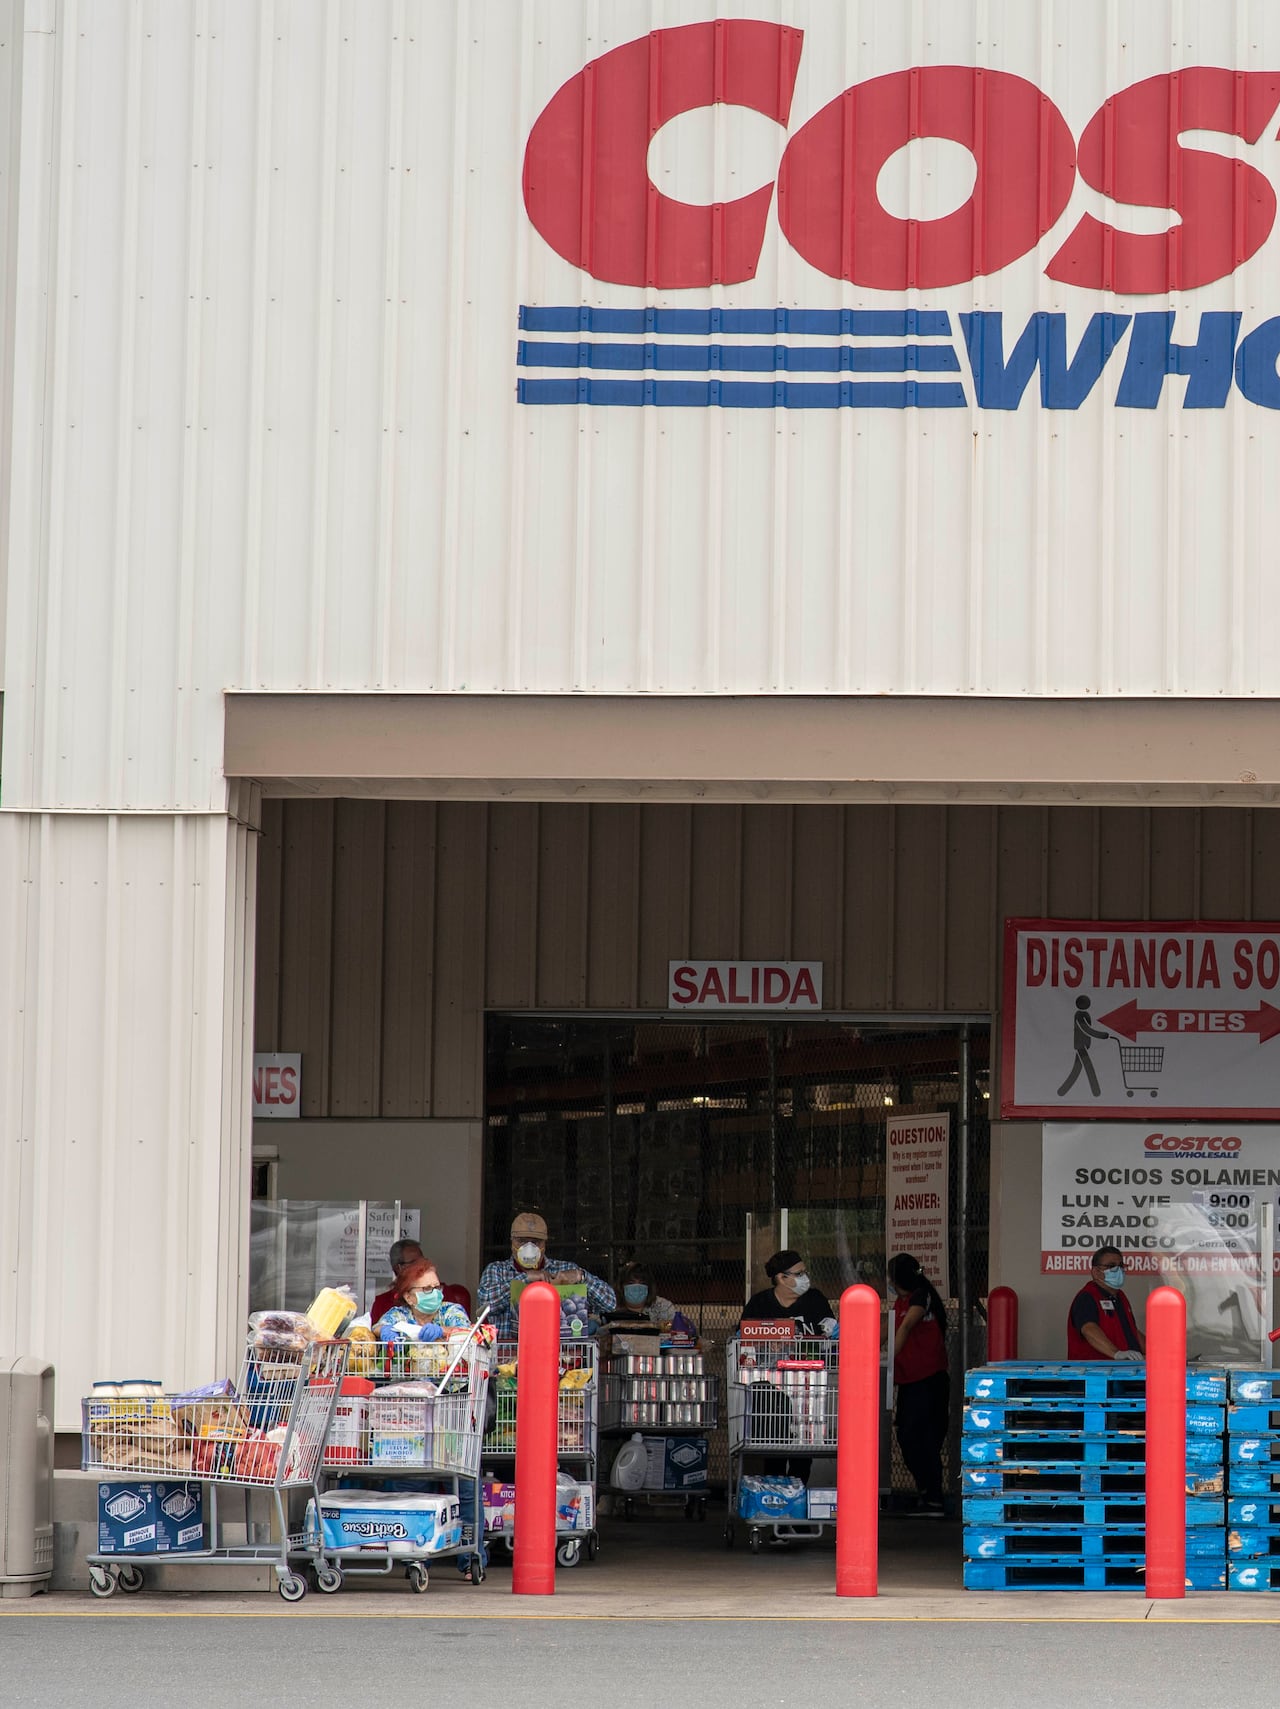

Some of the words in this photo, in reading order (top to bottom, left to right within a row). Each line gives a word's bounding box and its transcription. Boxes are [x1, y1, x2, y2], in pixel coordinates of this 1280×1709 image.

[1026, 938, 1220, 988] DISTANCIA
[671, 966, 818, 1004] SALIDA
[1151, 1012, 1168, 1031] 6
[1178, 1012, 1246, 1031] PIES
[890, 1126, 946, 1146] QUESTION:
[1144, 1133, 1241, 1151] COSTCO
[1174, 1151, 1240, 1159] WHOLESALE
[1075, 1168, 1163, 1185] SOCIOS
[894, 1193, 940, 1211] ANSWER:
[1061, 1195, 1109, 1208] LUN
[1131, 1195, 1171, 1208] VIE
[1209, 1194, 1251, 1209] 9:00
[404, 1213, 413, 1222] is
[1061, 1211, 1159, 1228] SÁBADO
[1061, 1234, 1176, 1249] DOMINGO
[1046, 1255, 1093, 1271] ABIERT
[1162, 1256, 1185, 1271] DEL
[743, 1326, 791, 1335] OUTDOOR
[109, 1495, 141, 1518] CLOROX
[128, 1527, 149, 1538] EMPAQUE
[129, 1532, 152, 1544] FAMILIAR
[182, 1531, 201, 1542] FAMILIAR
